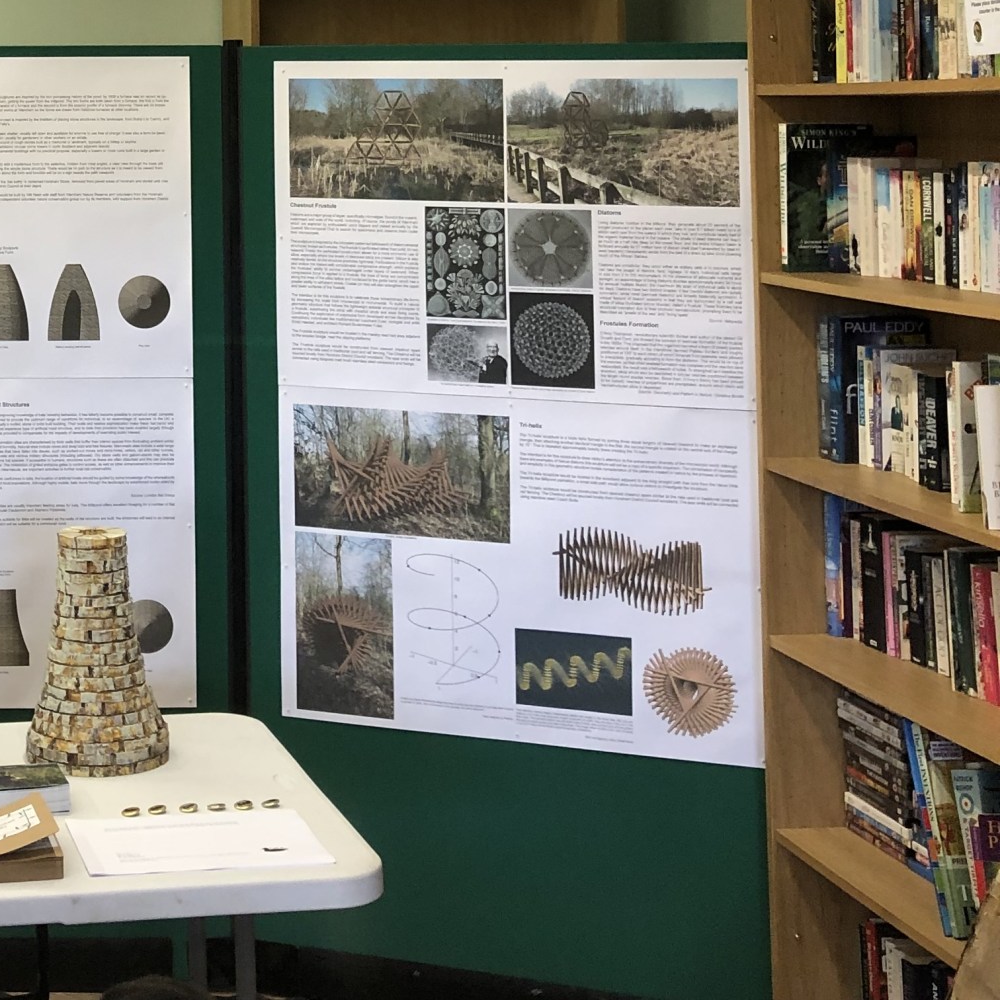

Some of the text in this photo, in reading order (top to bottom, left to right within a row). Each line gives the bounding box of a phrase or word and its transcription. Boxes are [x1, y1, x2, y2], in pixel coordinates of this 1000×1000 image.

[922, 180, 933, 221] CORNWELL
[845, 321, 923, 333] PAUL EDDY
[925, 402, 937, 449] DEAVER
[920, 768, 935, 822] INVENTIONS
